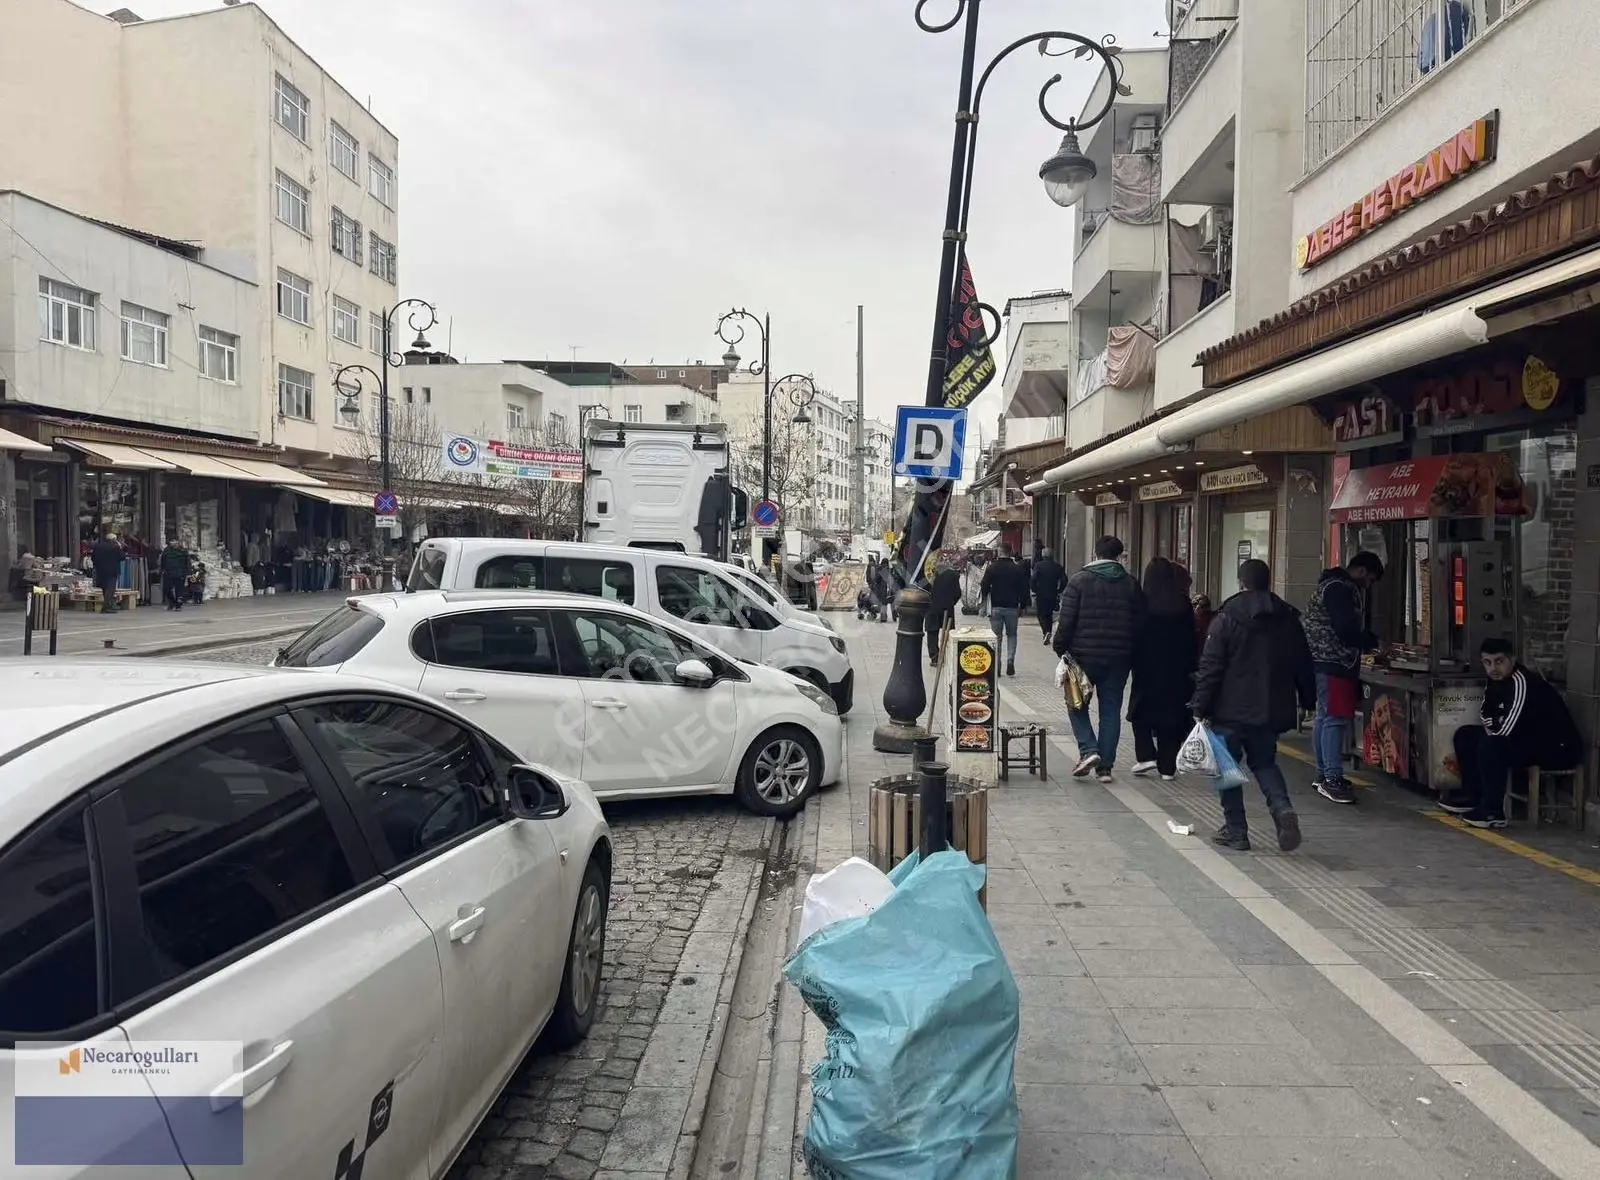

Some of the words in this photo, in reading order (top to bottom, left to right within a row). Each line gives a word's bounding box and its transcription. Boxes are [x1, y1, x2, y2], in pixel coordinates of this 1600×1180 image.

[1308, 203, 1361, 263] ABEE
[1361, 120, 1485, 229] HEYRANN
[1333, 397, 1387, 441] FAST
[914, 423, 943, 460] D
[1389, 464, 1414, 480] ABE
[1366, 484, 1420, 500] HEYRANN
[1348, 510, 1362, 521] ABE
[1364, 506, 1404, 520] HEYRANN
